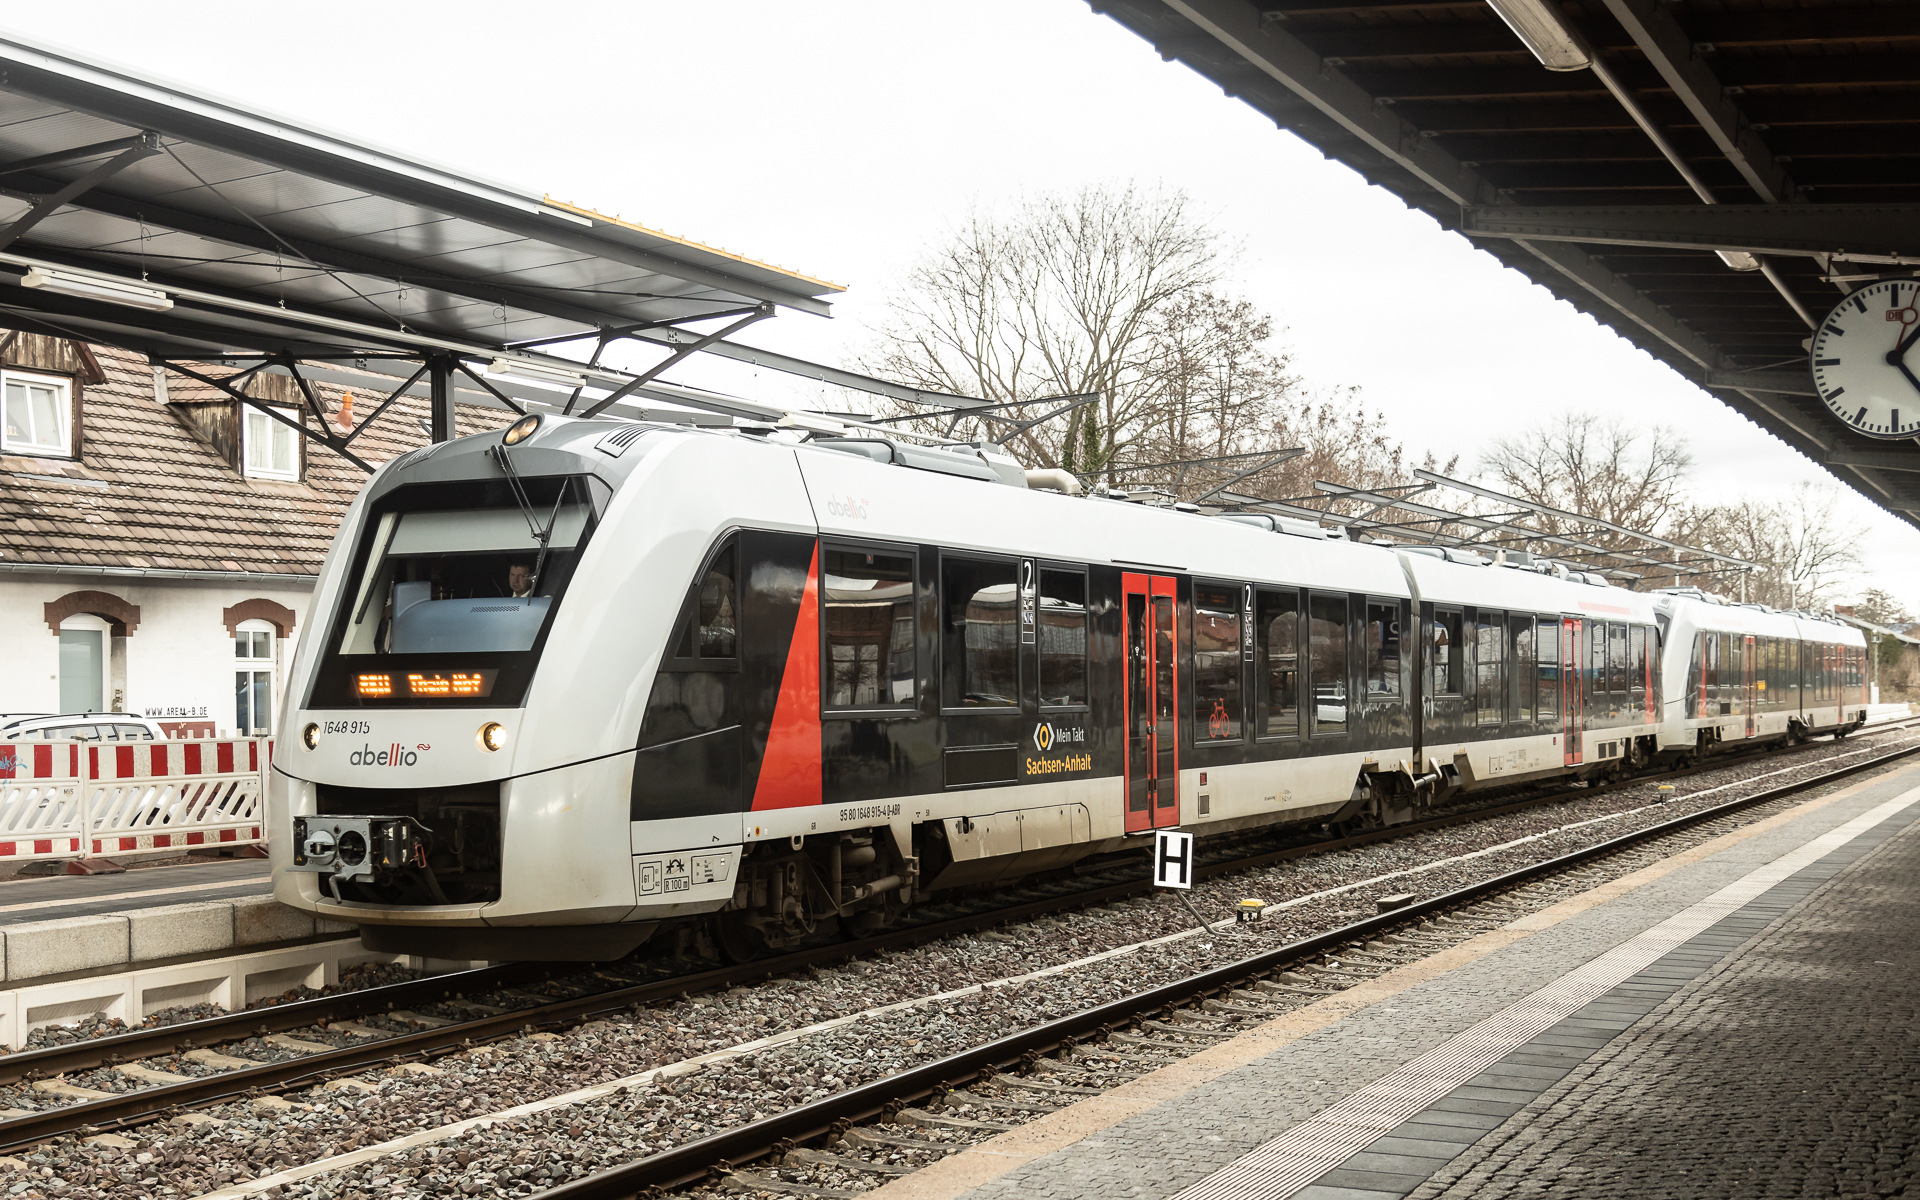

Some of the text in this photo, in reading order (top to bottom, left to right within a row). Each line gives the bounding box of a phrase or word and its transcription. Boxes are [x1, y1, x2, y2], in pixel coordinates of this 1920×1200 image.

[827, 494, 867, 520] abellio
[1024, 561, 1033, 593] 2
[1245, 584, 1252, 611] 2
[408, 673, 450, 693] Thale
[452, 673, 482, 692] Hbf
[323, 720, 370, 734] 1648 915
[1056, 726, 1085, 743] Mein Takt
[349, 743, 418, 767] abellio
[1026, 753, 1092, 775] Sachsen-Anhalt
[840, 803, 901, 821] 95 80 1648 915-4 D-ABR
[1158, 835, 1189, 884] H
[666, 881, 670, 890] R
[671, 879, 682, 890] 100
